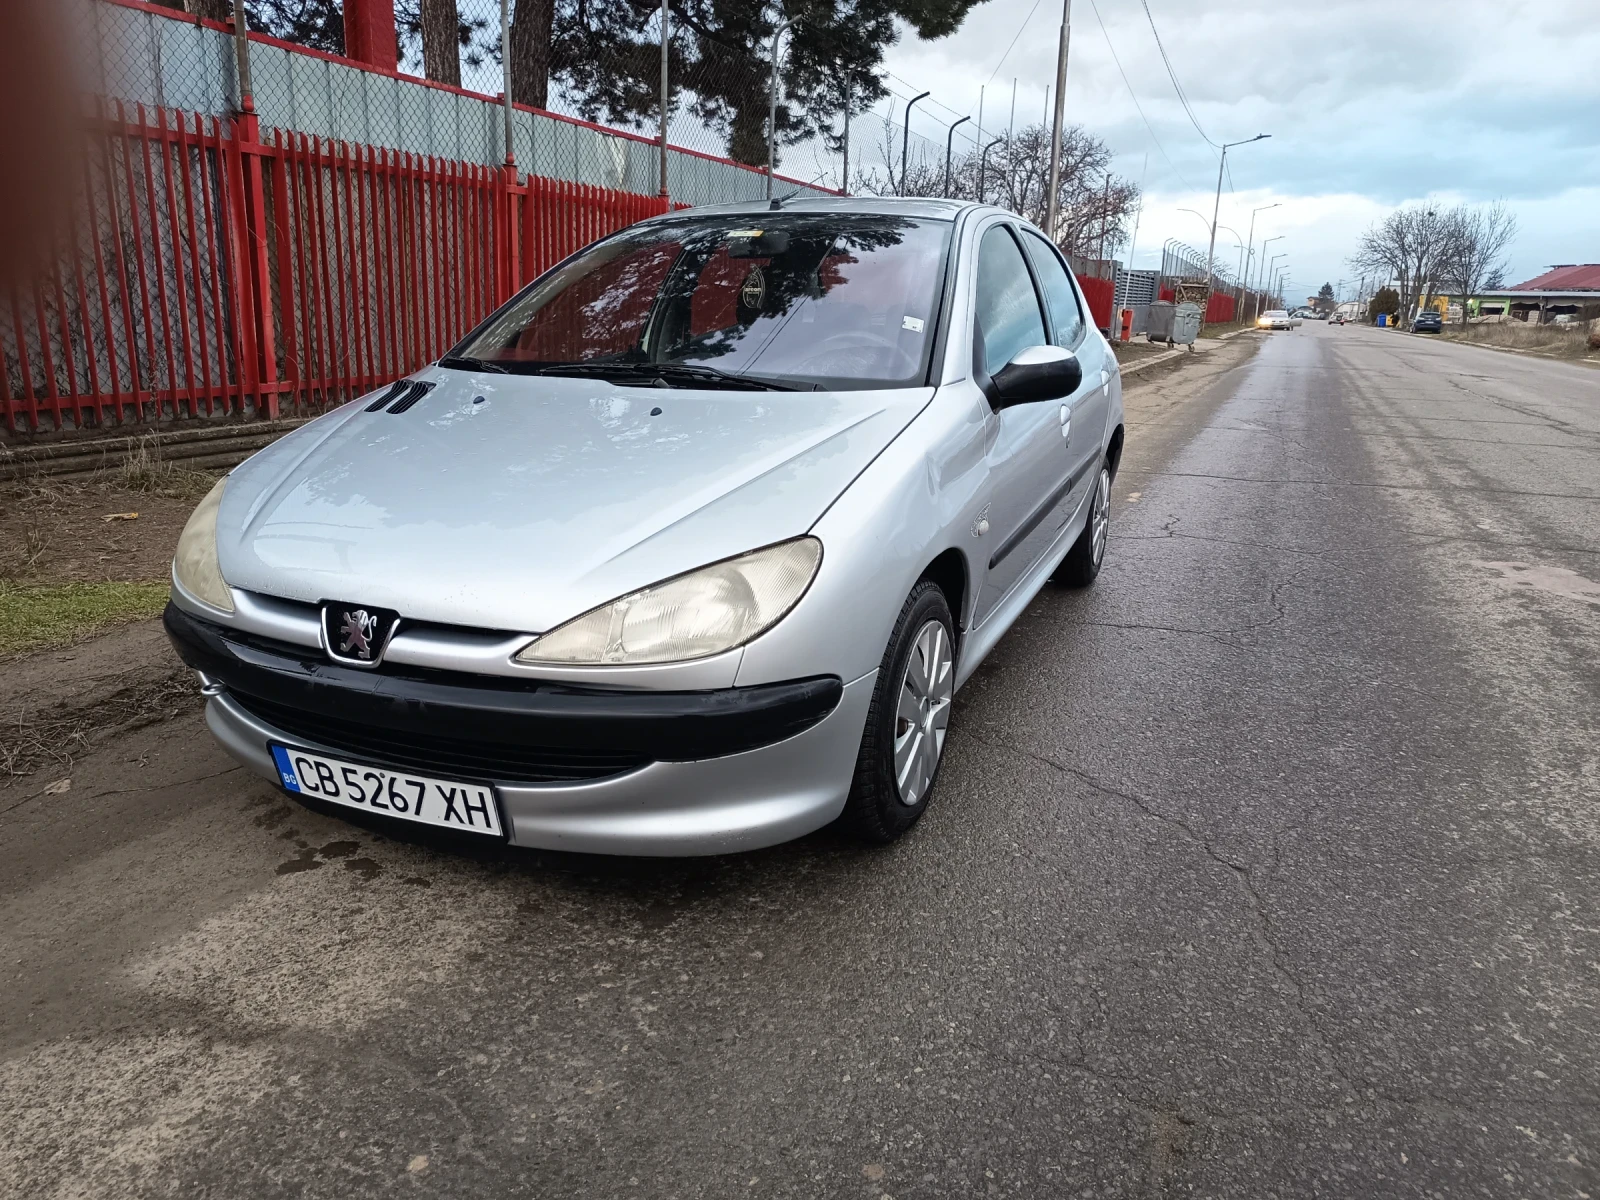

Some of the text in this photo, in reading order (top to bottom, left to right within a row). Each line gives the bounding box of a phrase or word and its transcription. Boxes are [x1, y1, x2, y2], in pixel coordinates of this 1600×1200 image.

[282, 772, 297, 785] BG
[341, 767, 425, 816] 5267
[435, 785, 492, 829] XH
